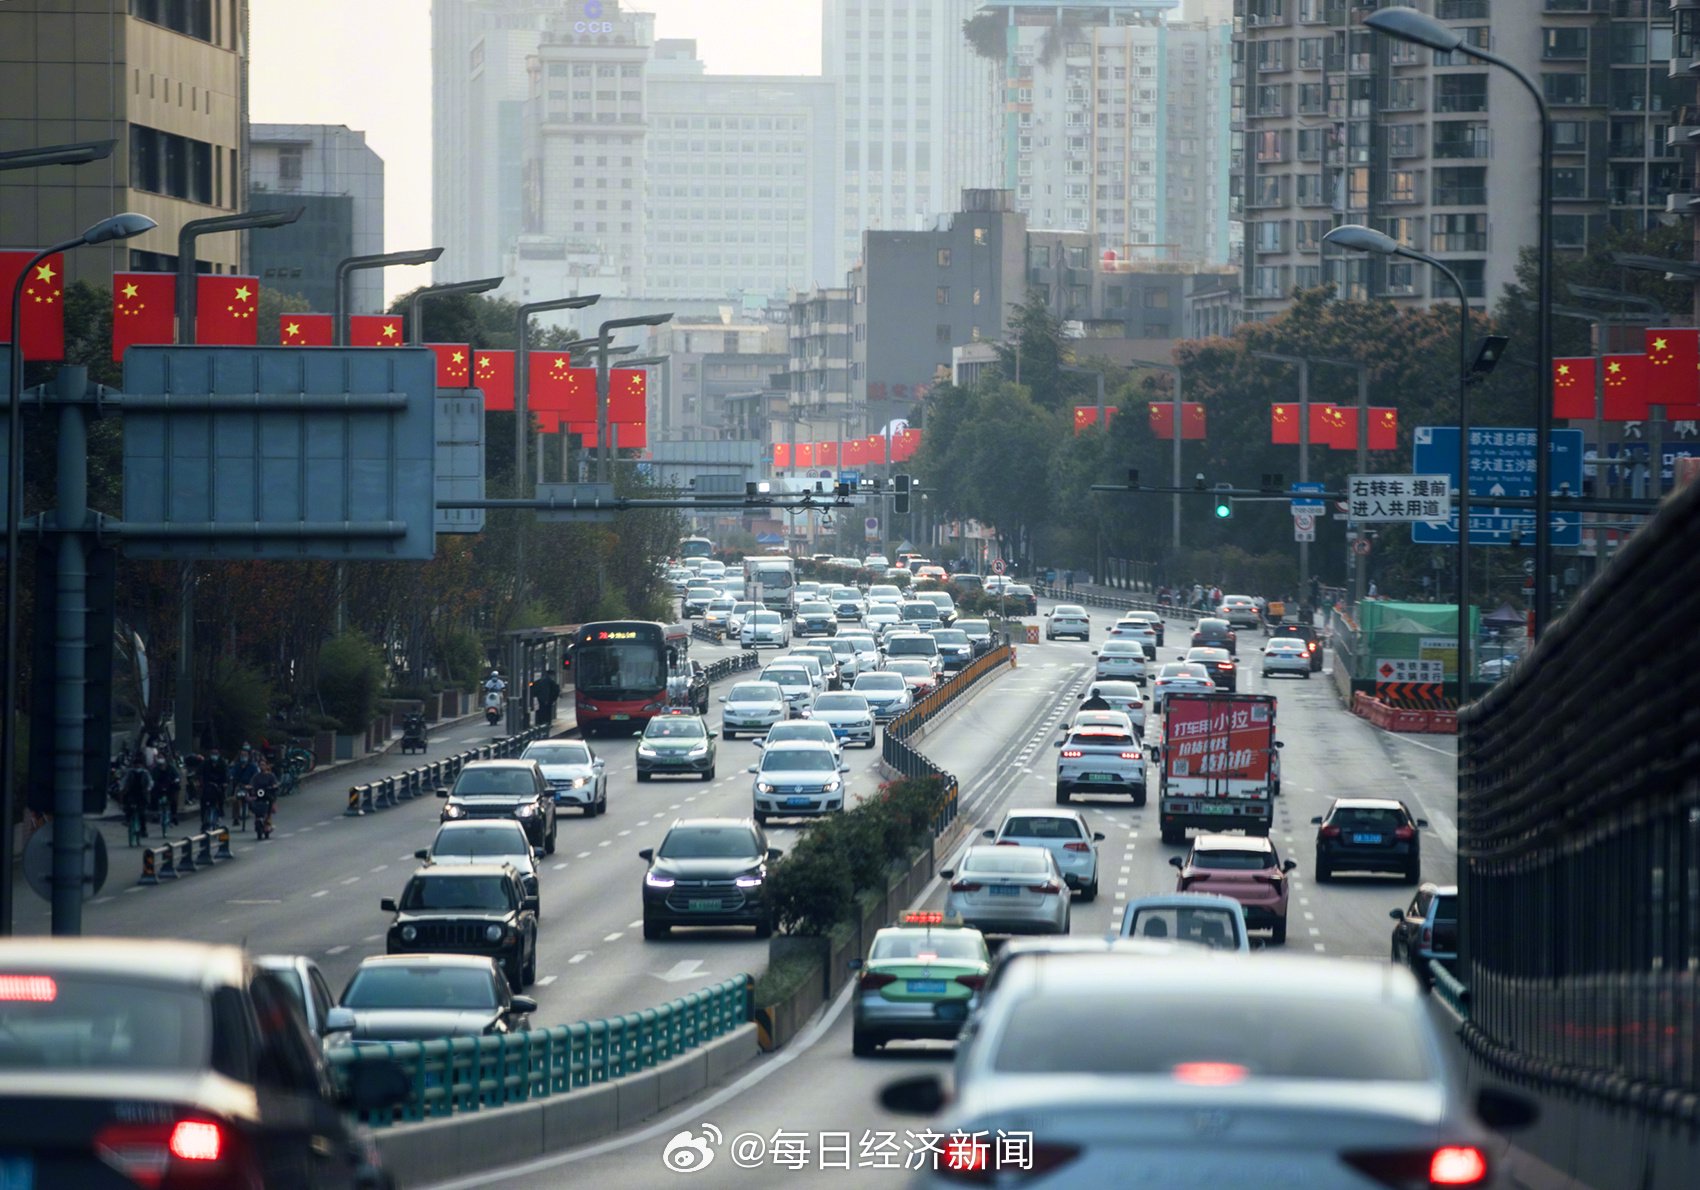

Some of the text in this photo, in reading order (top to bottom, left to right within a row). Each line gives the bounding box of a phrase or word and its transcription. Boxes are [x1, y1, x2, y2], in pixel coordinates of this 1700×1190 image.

[574, 21, 613, 33] CCB
[1470, 432, 1538, 446] 都大道总府路
[1470, 459, 1538, 473] 华大道玉沙路
